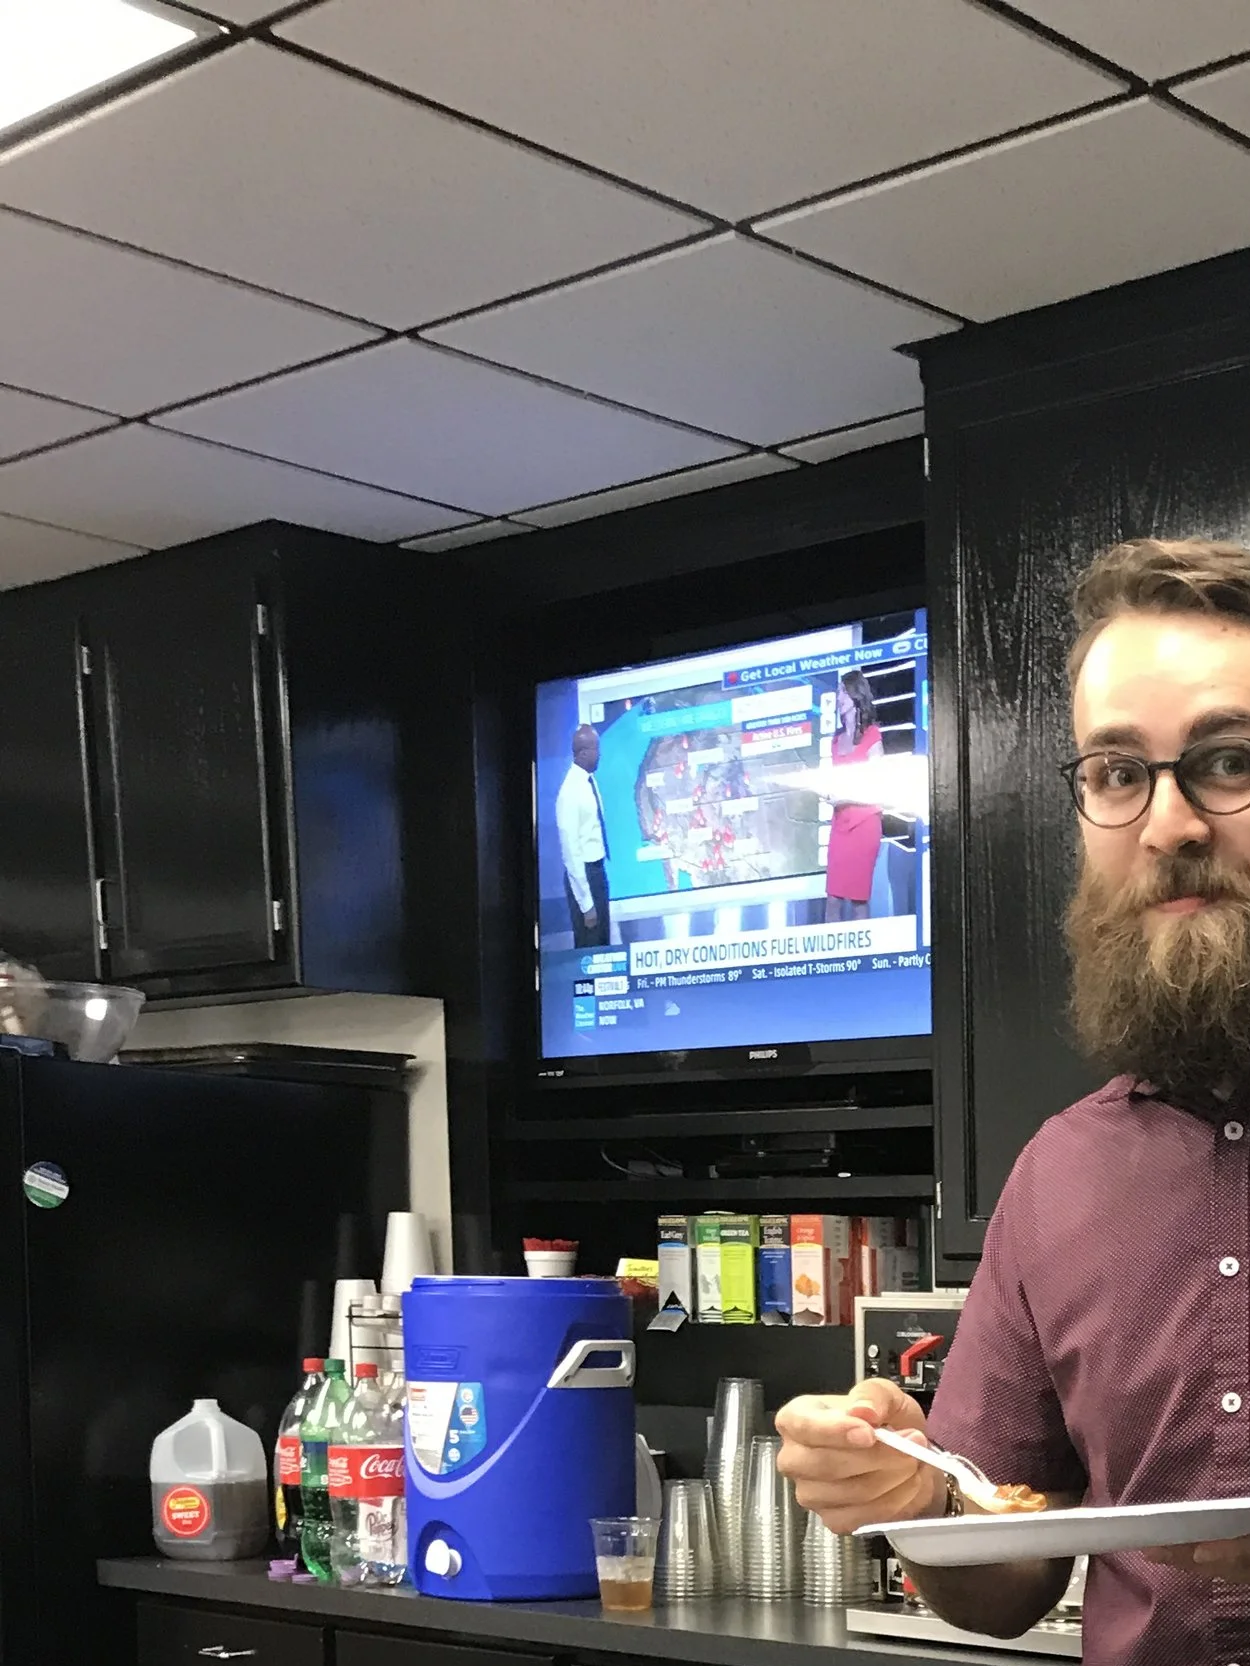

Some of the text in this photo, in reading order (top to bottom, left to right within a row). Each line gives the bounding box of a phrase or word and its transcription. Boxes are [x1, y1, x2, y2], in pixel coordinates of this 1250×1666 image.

[741, 648, 883, 682] Get Local Weather Now
[635, 950, 663, 969] HOT,
[665, 948, 690, 966] DRY
[692, 940, 768, 963] CONDITIONS
[771, 937, 799, 955] FUEL
[802, 930, 871, 953] WILDFIRES
[655, 976, 667, 987] PM
[668, 973, 726, 986] Thunderstorms
[752, 968, 768, 979] Sat.
[774, 964, 807, 978] Isolated
[808, 961, 845, 975] T-Storms
[872, 957, 891, 969] Sun.
[898, 954, 924, 967] Partly
[749, 1049, 778, 1059] PHILIPS
[449, 1430, 460, 1444] 5
